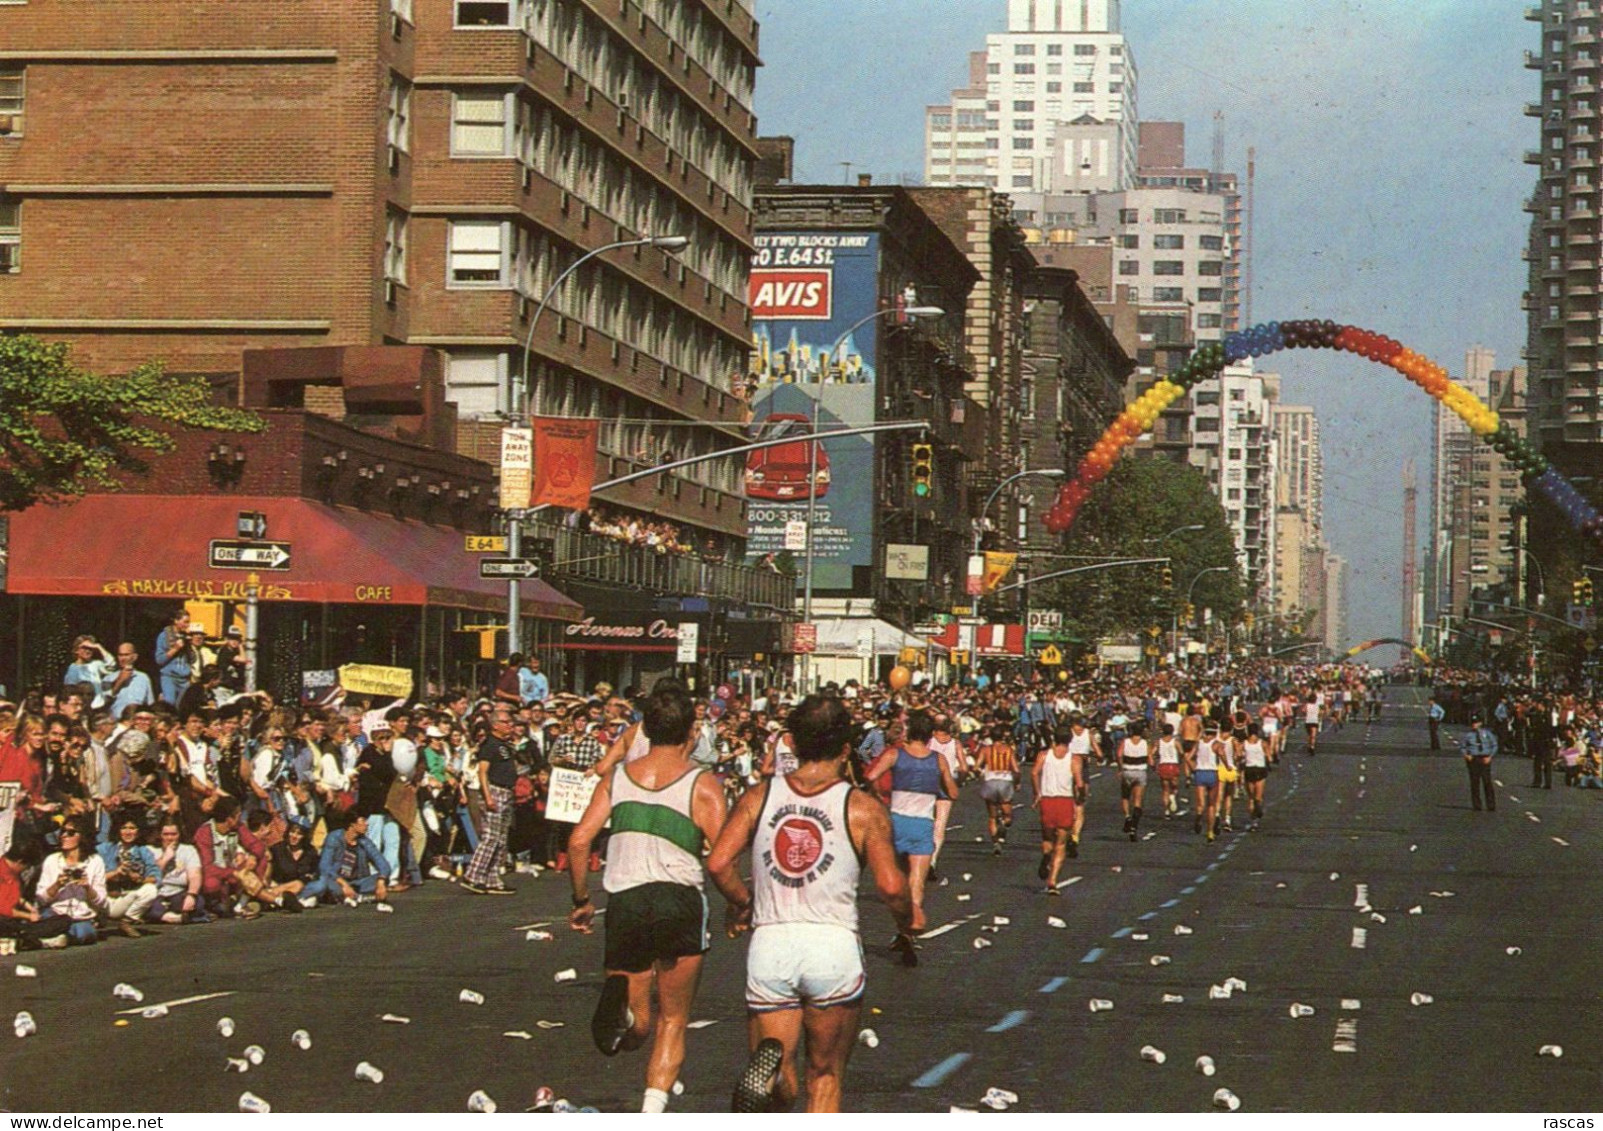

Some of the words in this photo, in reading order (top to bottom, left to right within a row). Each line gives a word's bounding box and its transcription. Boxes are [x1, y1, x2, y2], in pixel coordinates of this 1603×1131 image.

[771, 236, 796, 246] TWO
[798, 236, 838, 247] BLOCKS
[839, 236, 870, 247] AWAY
[753, 281, 822, 307] AVIS
[505, 443, 528, 451] AWAY
[505, 453, 528, 462] ZONE
[467, 538, 474, 549] E
[478, 538, 493, 549] 64
[217, 549, 242, 559] ONE
[256, 550, 280, 561] WAY
[132, 580, 214, 595] MAXWELL'S
[355, 585, 391, 600] CAFE
[566, 616, 644, 637] Avenue
[1029, 613, 1060, 627] DELI
